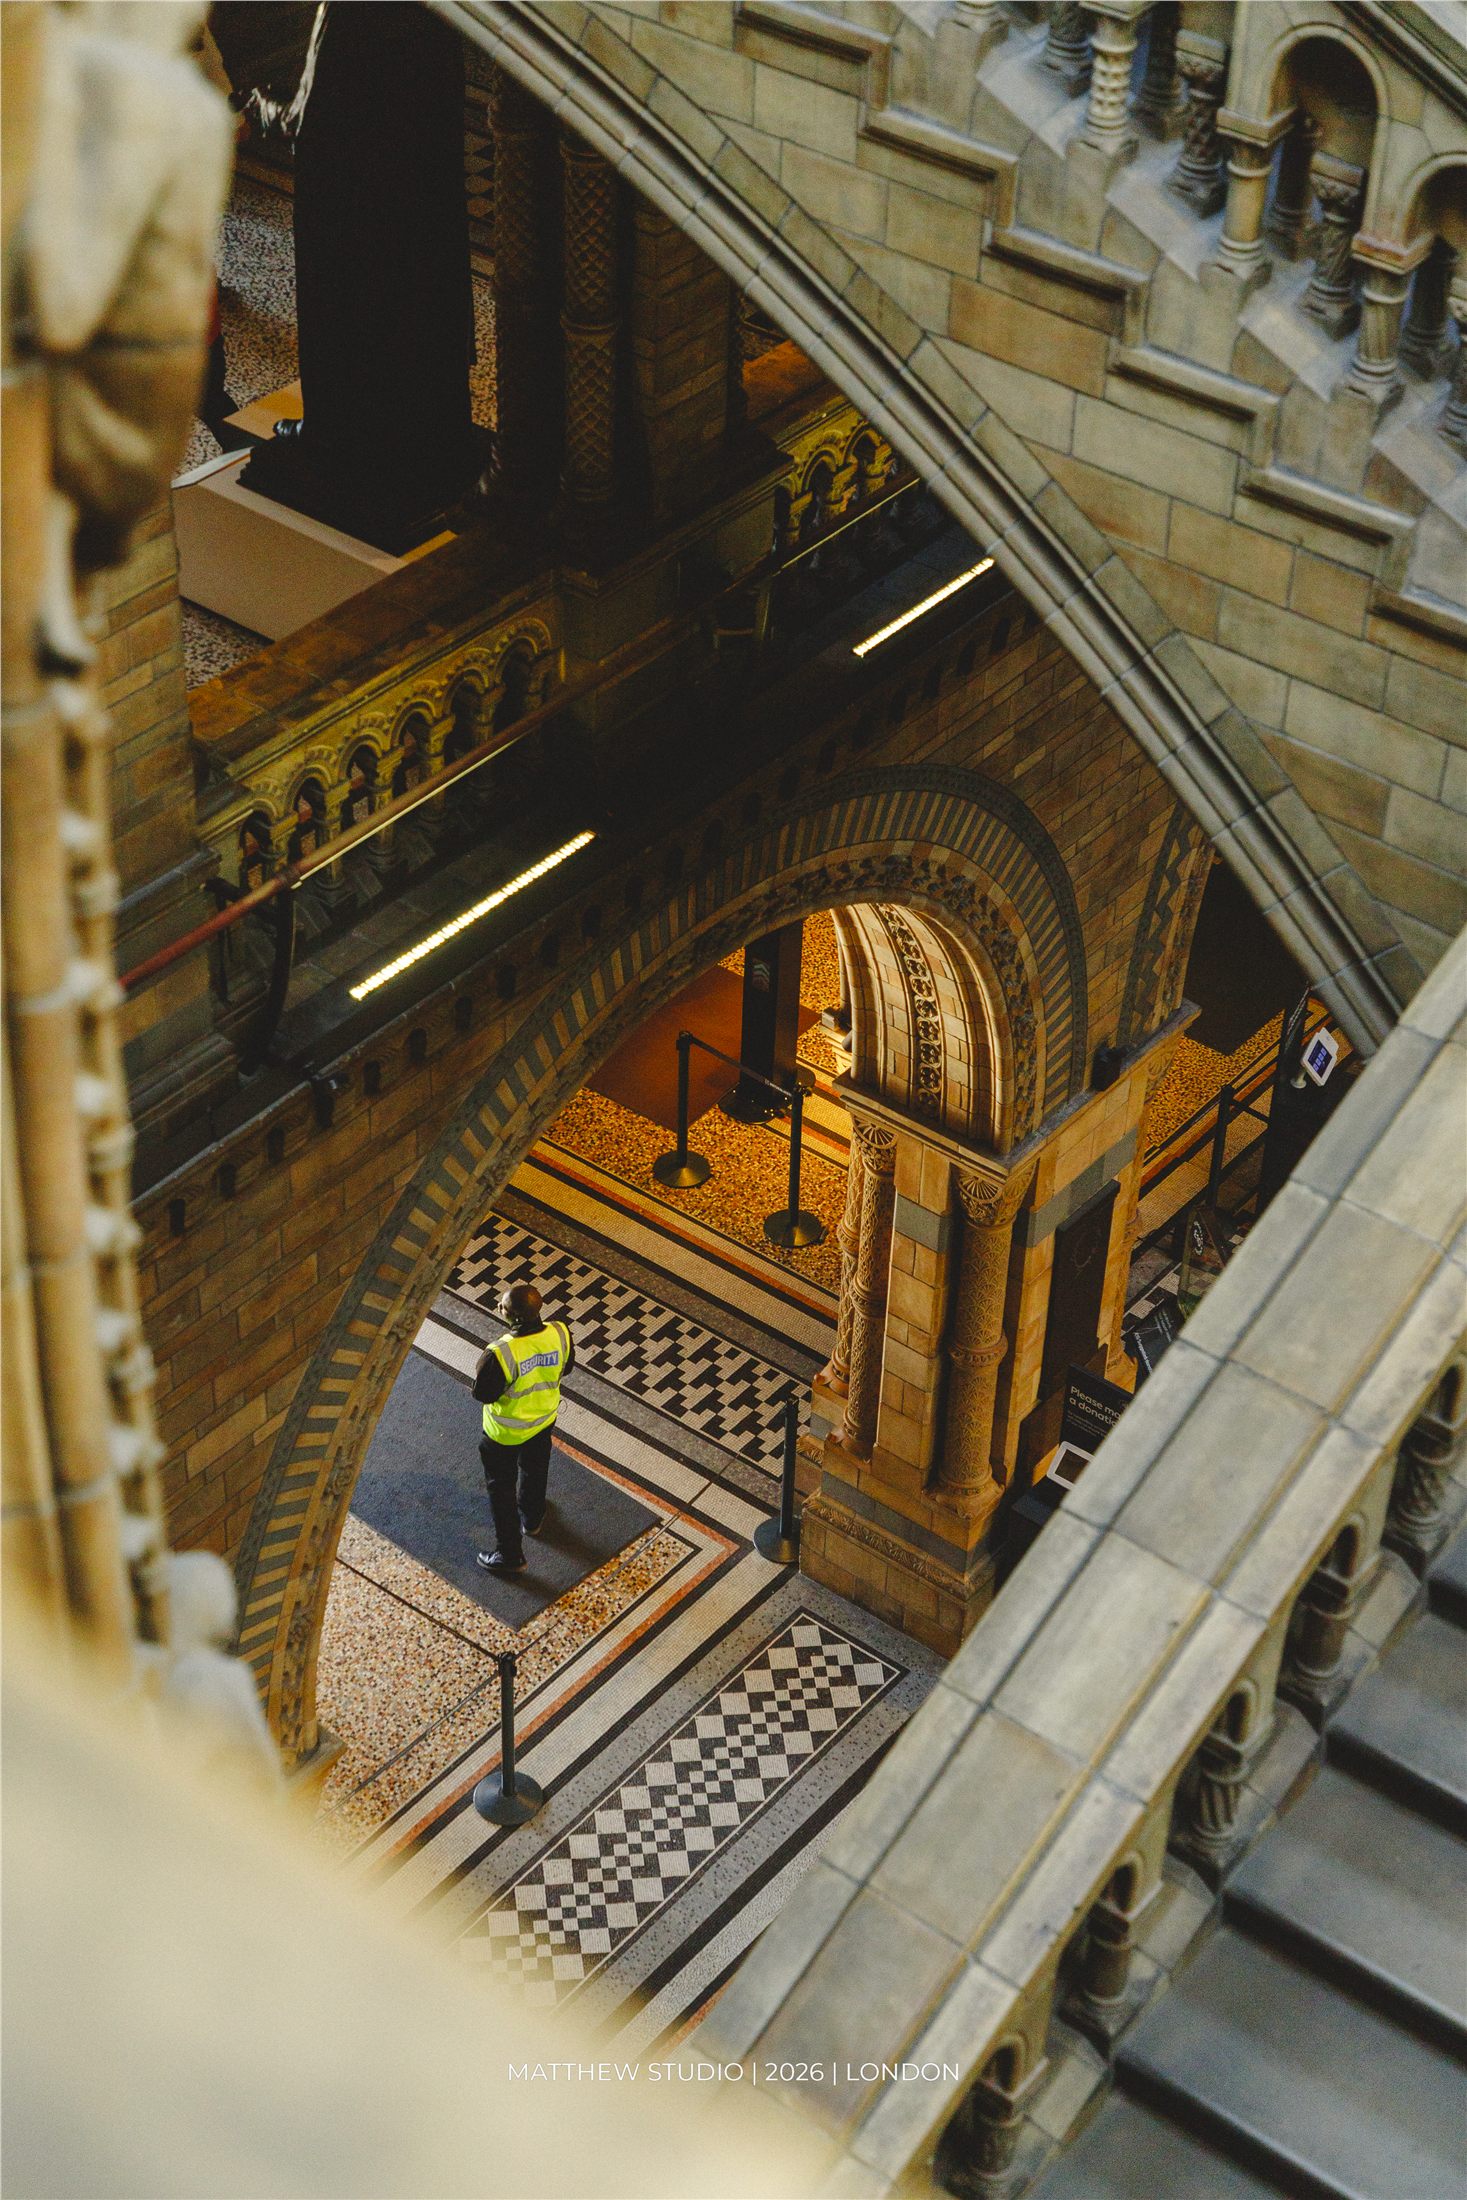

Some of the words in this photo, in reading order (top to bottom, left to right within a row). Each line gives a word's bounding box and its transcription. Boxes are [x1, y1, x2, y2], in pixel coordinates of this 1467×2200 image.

[521, 1352, 558, 1375] SECURITY
[1069, 1397, 1077, 1406] a
[1070, 1386, 1103, 1410] Please
